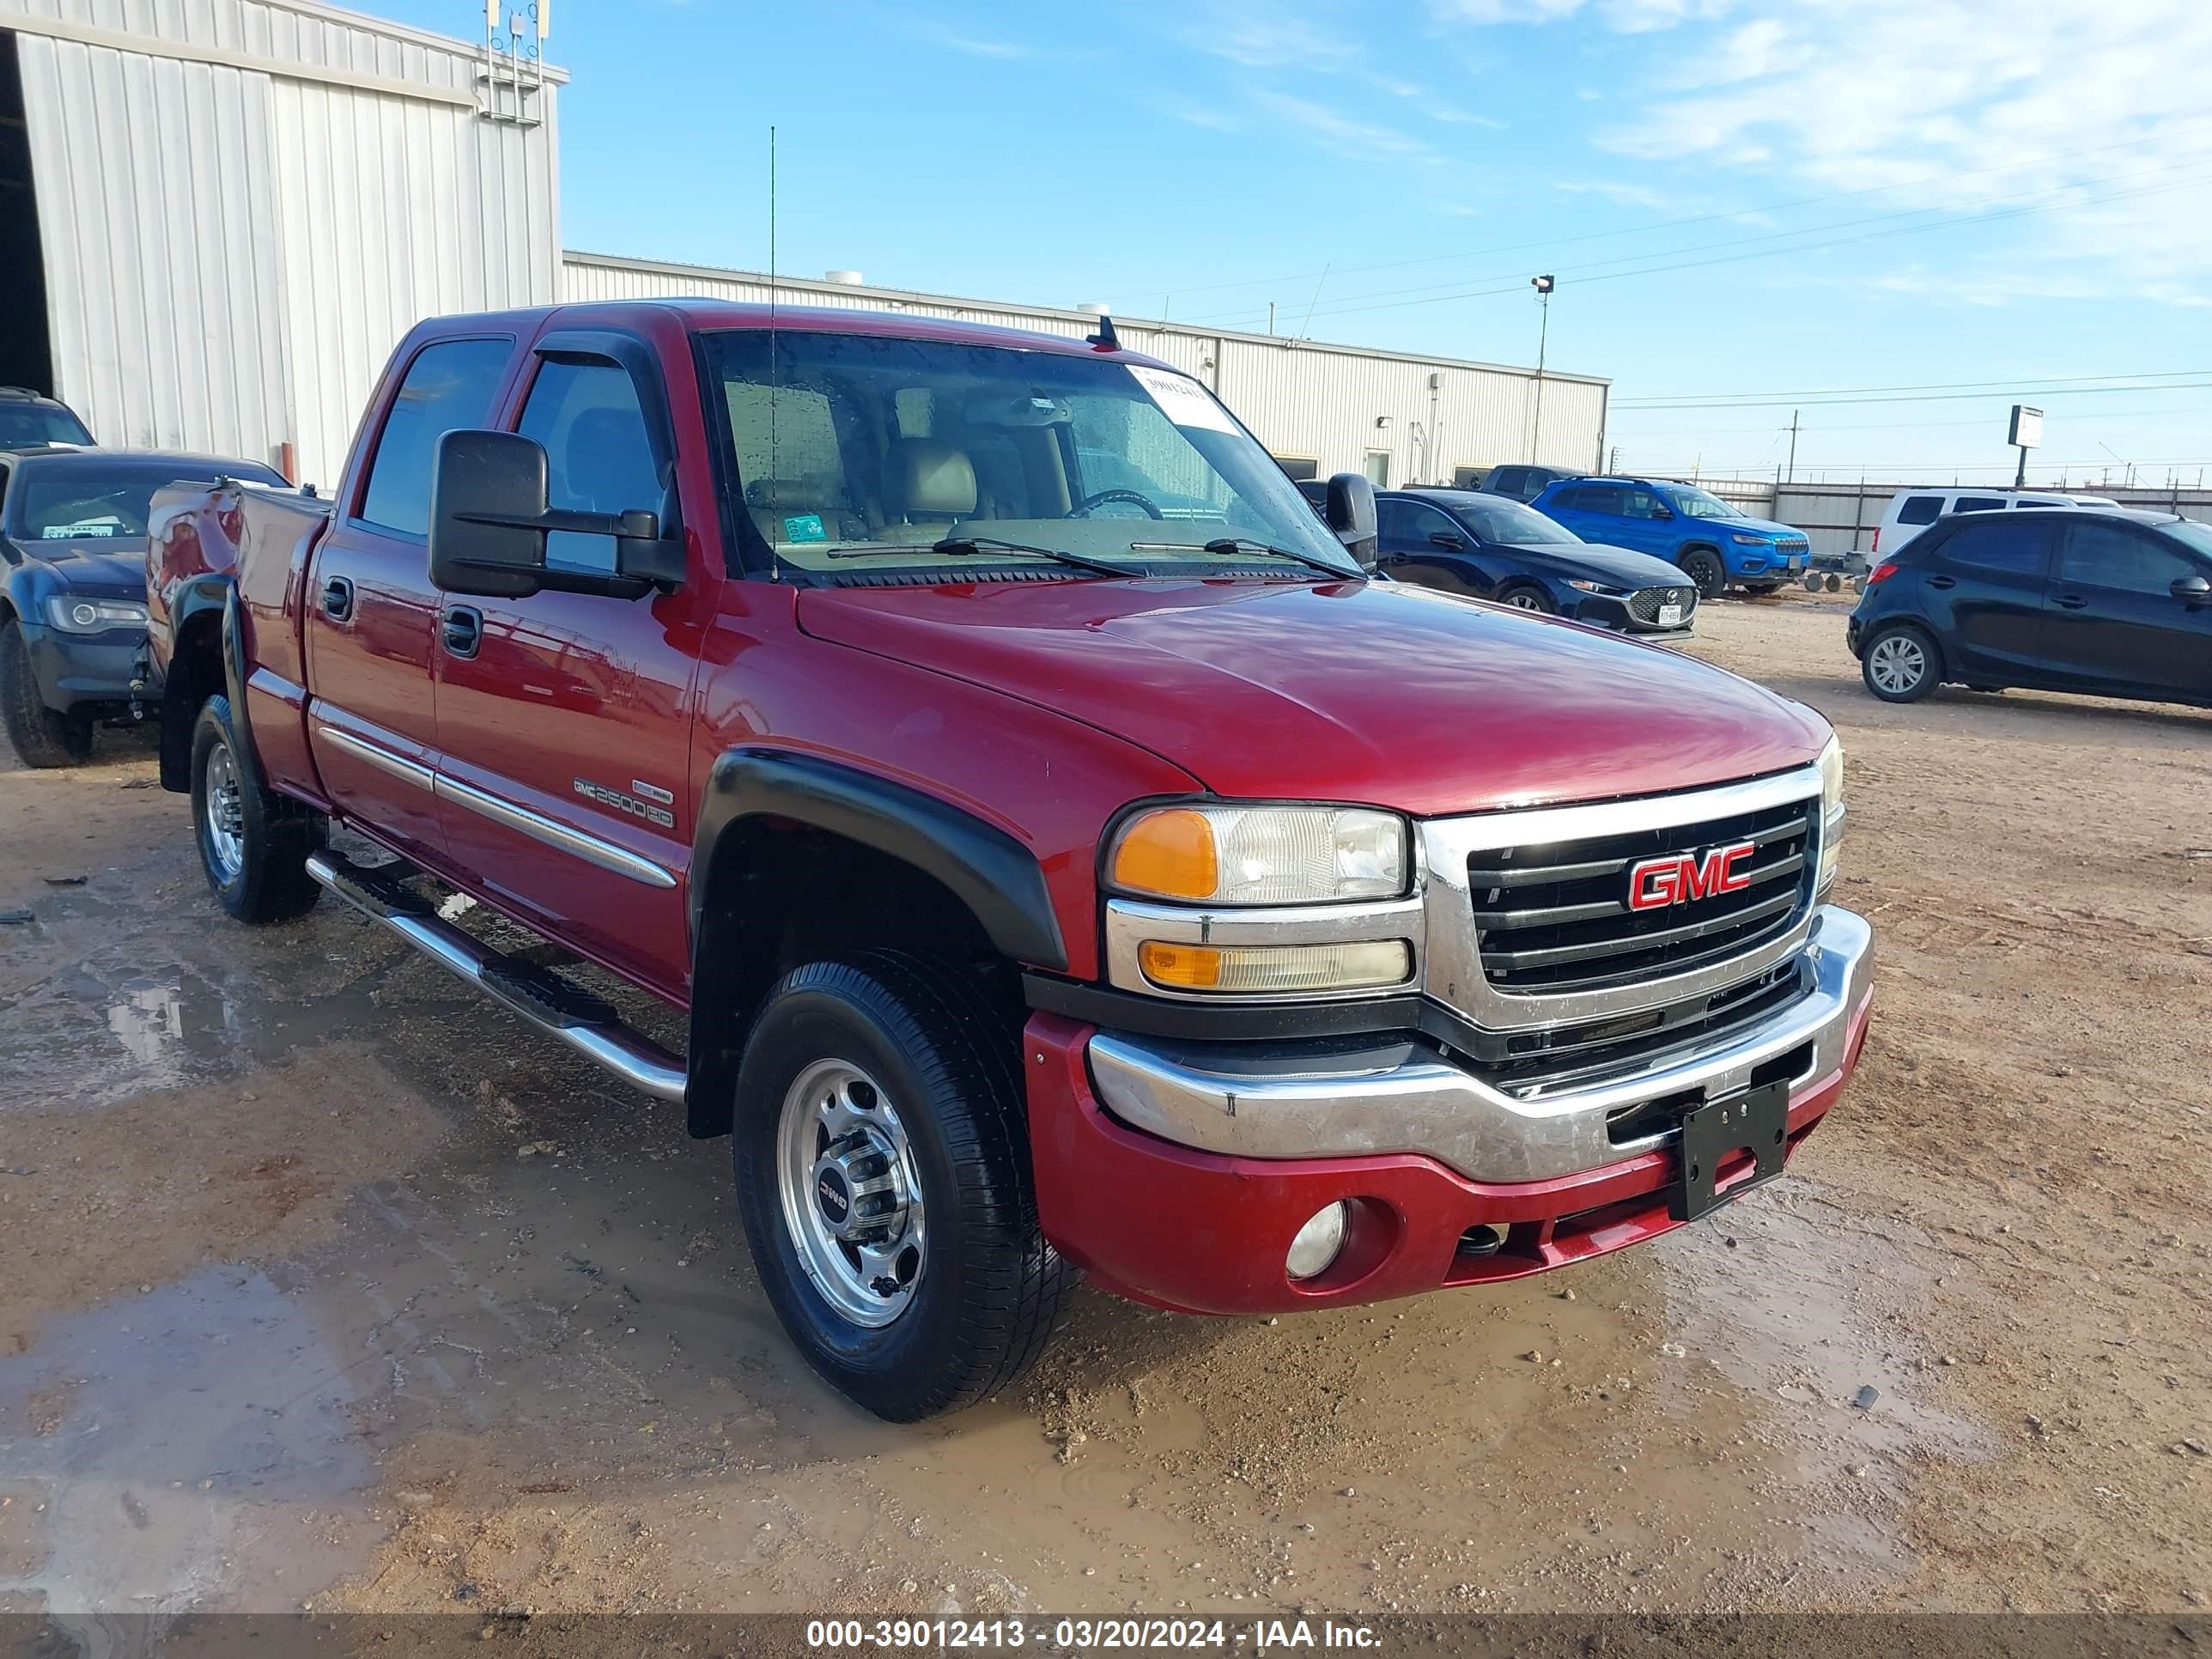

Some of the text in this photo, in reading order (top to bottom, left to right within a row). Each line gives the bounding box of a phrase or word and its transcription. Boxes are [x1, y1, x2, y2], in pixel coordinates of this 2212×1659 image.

[787, 520, 800, 539] 2023
[1629, 841, 1755, 912] GMC
[819, 1180, 848, 1210] GMC
